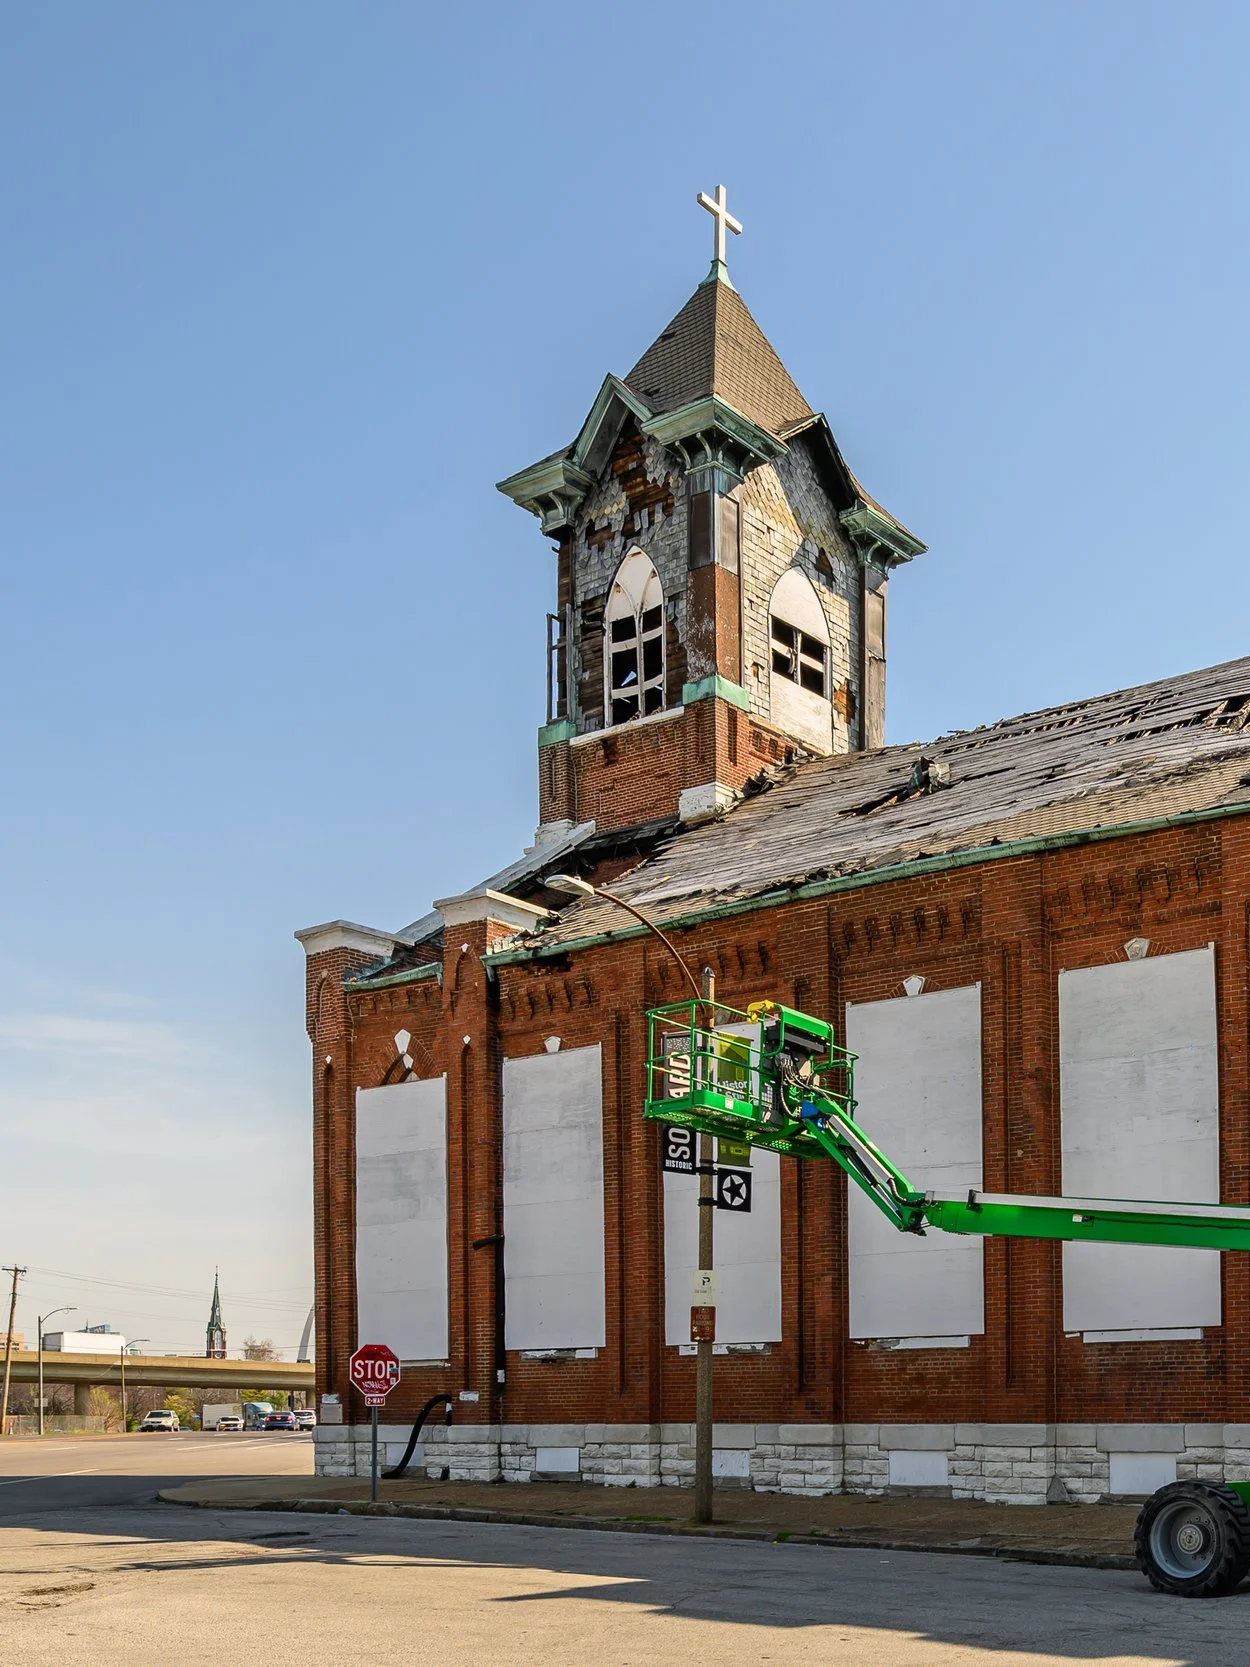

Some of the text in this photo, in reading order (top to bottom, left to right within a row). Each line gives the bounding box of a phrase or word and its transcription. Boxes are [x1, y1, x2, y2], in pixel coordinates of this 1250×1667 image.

[668, 1051, 692, 1160] SOARD
[665, 1159, 692, 1170] HISTORIC
[354, 1360, 397, 1379] STOP
